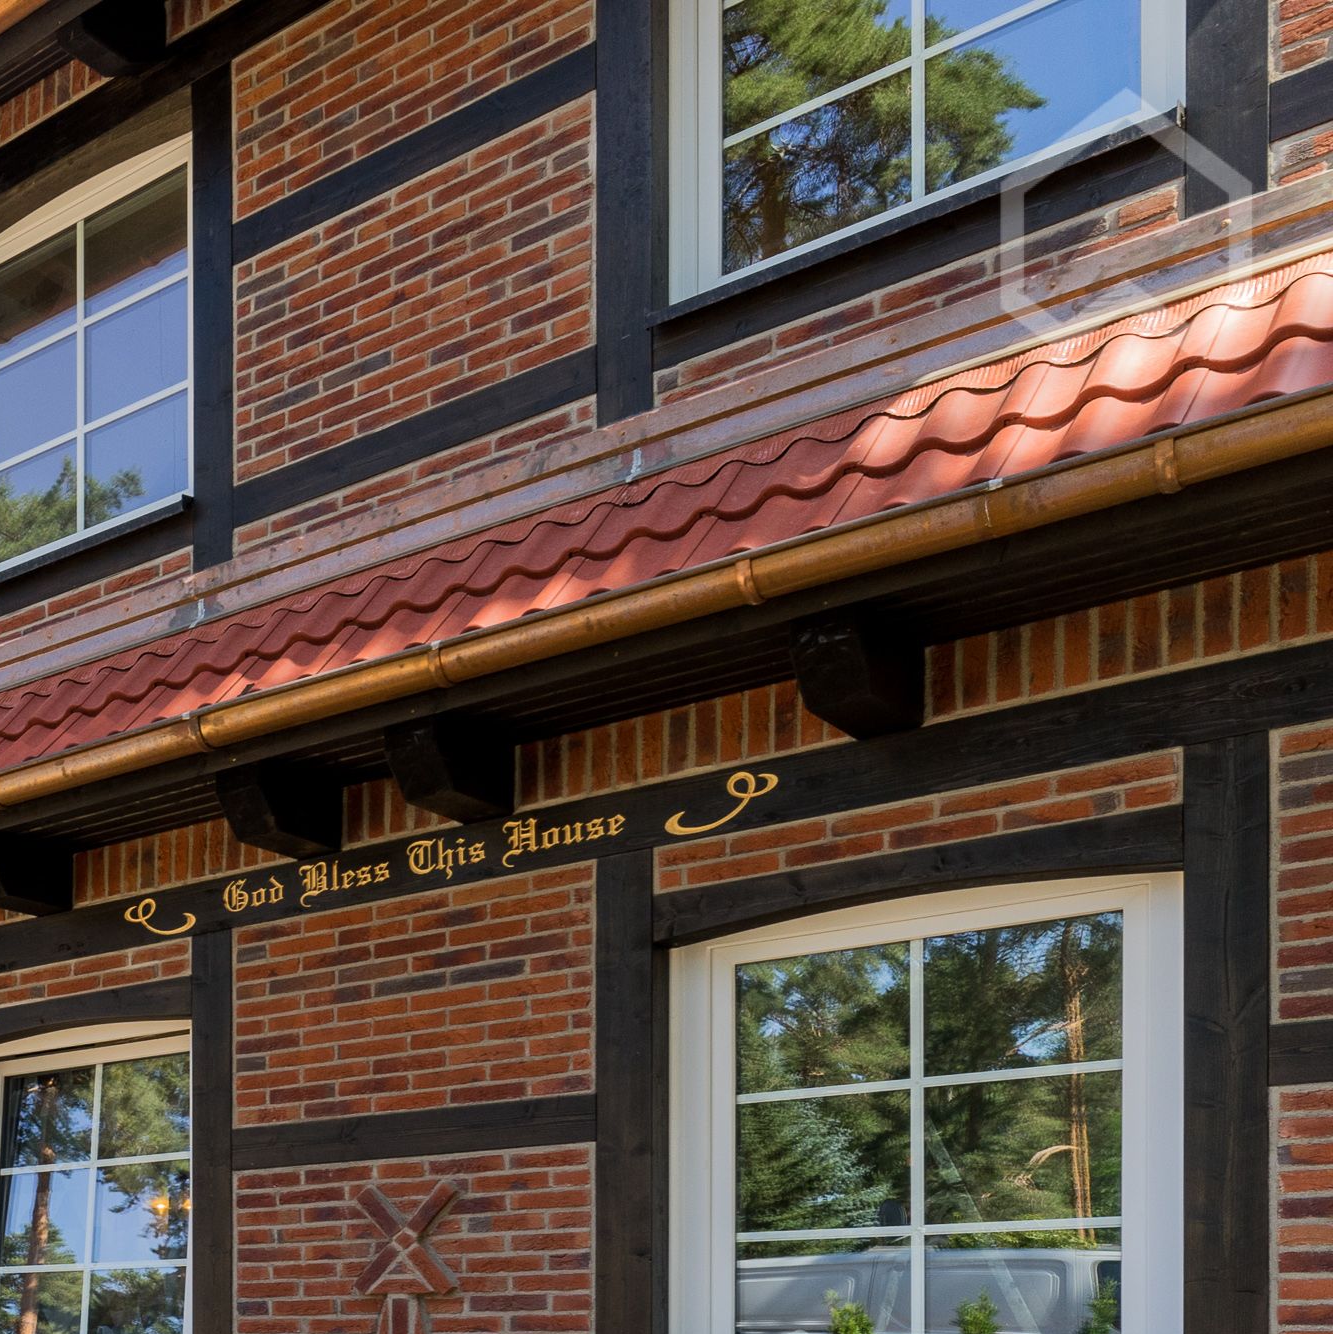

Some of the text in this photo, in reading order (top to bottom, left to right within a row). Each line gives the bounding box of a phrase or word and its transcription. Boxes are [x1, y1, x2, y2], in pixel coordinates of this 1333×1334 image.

[223, 814, 627, 913] God Bless This House
